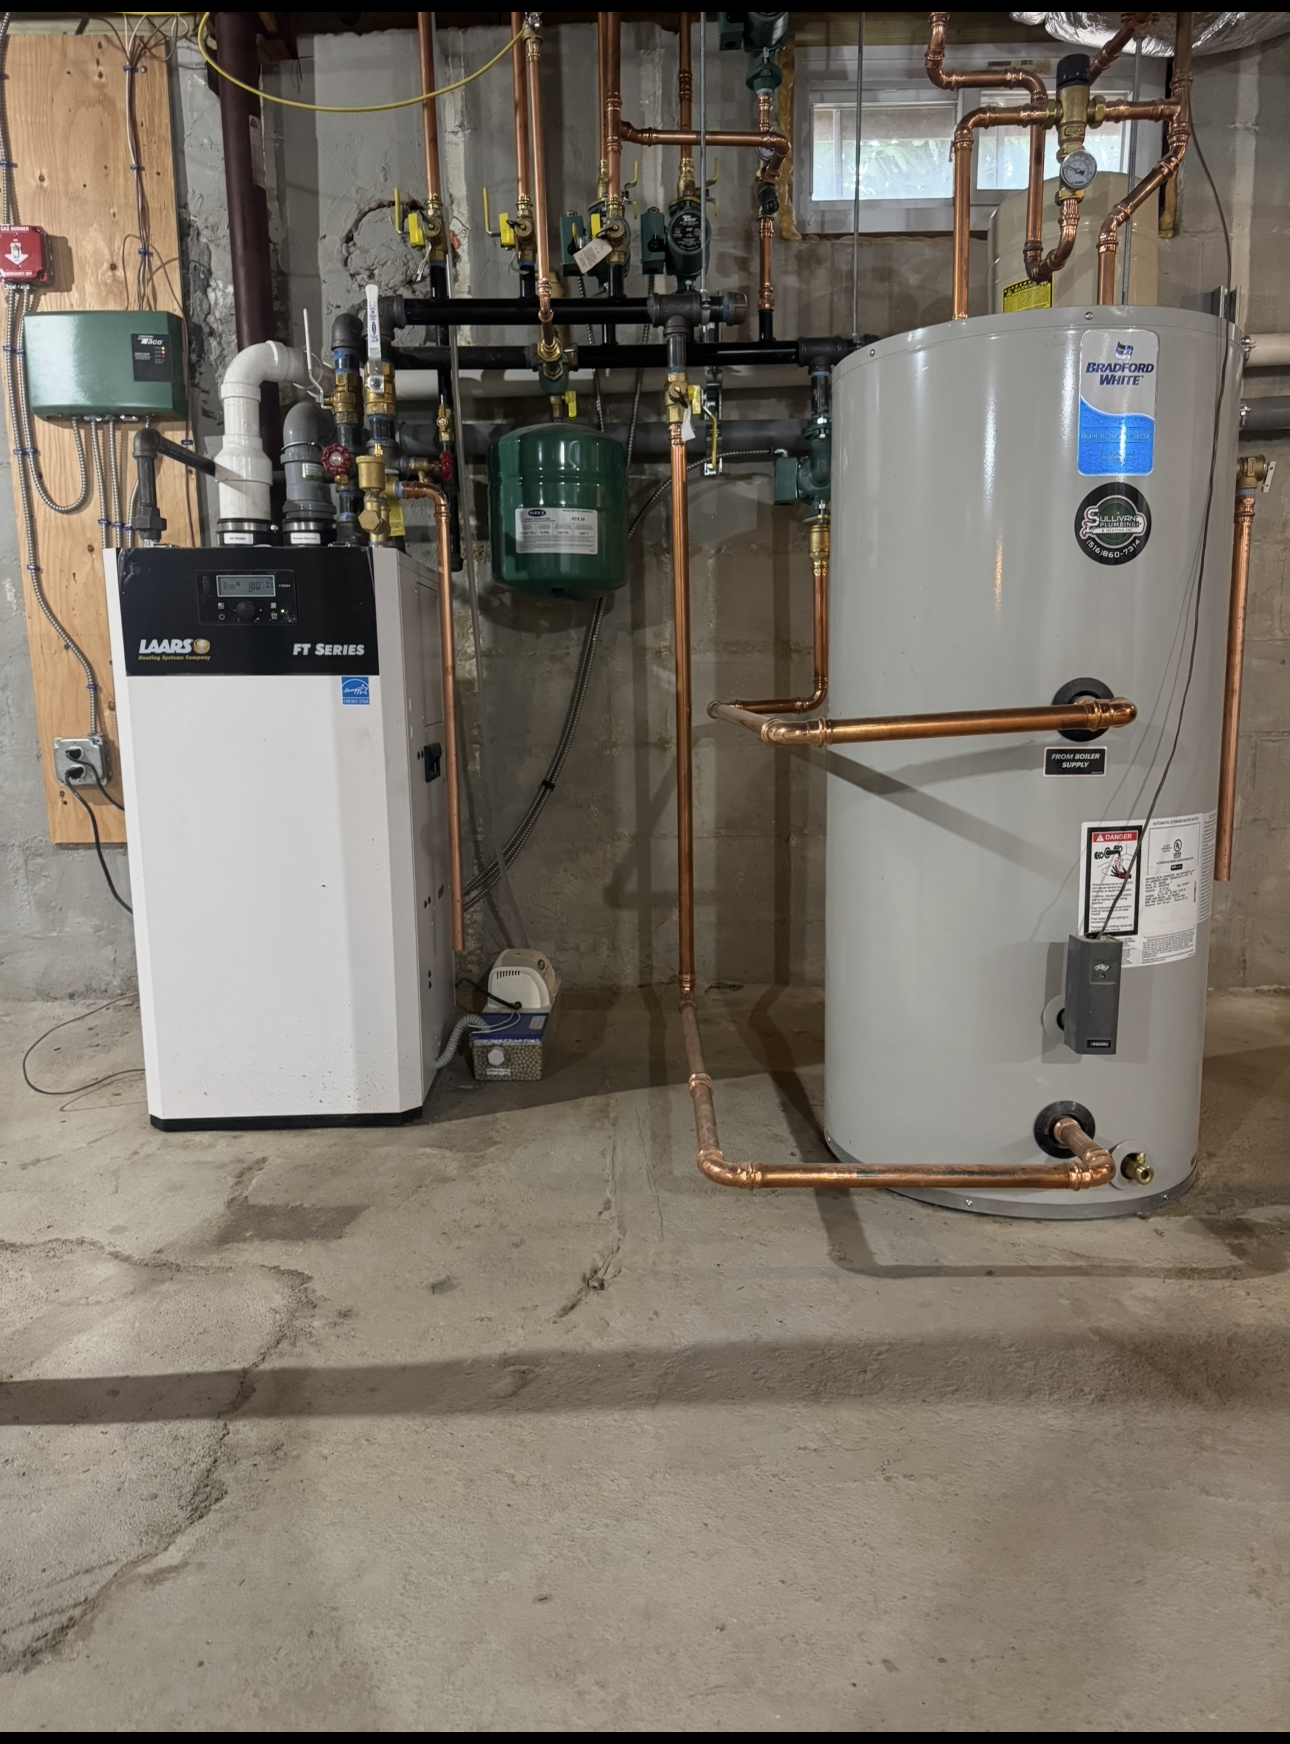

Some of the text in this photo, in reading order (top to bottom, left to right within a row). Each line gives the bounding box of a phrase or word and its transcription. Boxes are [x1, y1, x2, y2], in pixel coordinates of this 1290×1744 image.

[1085, 362, 1154, 373] BRADFORD
[1088, 509, 1136, 525] SULLIVAN
[139, 639, 193, 653] LAARS
[293, 643, 365, 656] FT SERIES
[1061, 761, 1090, 769] SUPPLY
[1105, 833, 1133, 841] DANGER
